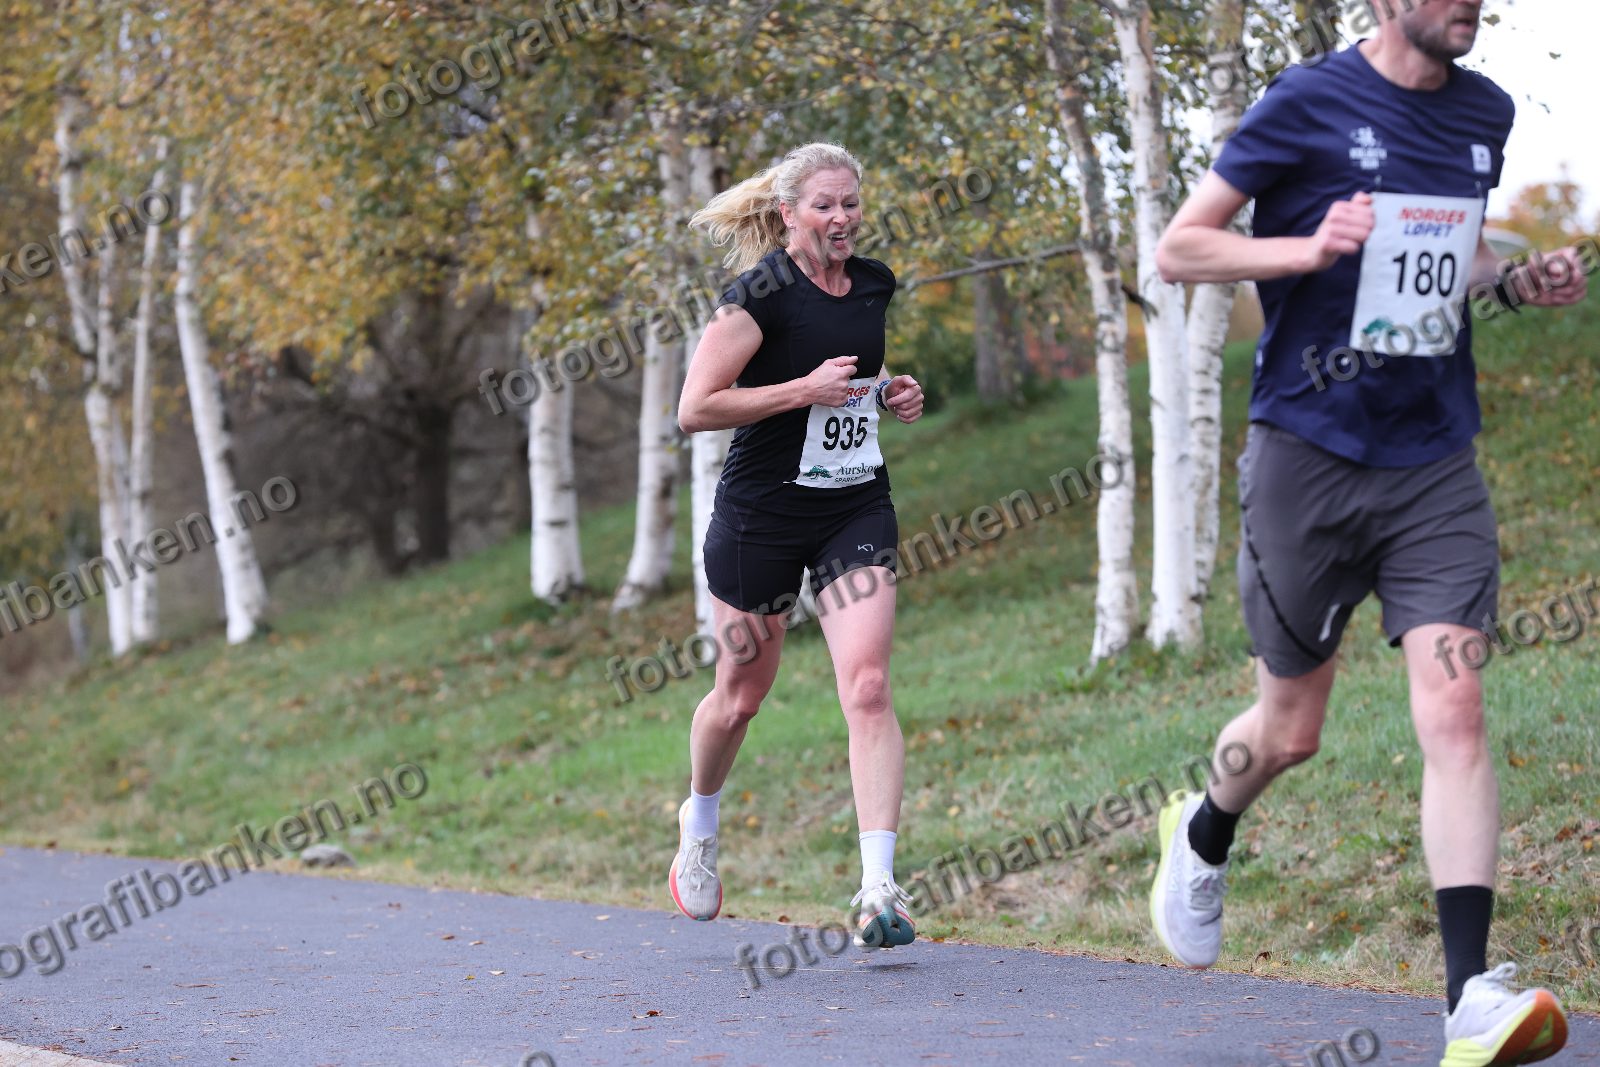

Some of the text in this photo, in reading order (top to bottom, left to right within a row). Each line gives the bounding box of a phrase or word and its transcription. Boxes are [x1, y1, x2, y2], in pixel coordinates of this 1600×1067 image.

[1399, 207, 1468, 224] NORGES
[1404, 222, 1456, 238] LØPET
[1392, 250, 1457, 298] 180
[846, 385, 870, 397] RGES
[822, 416, 869, 451] 935
